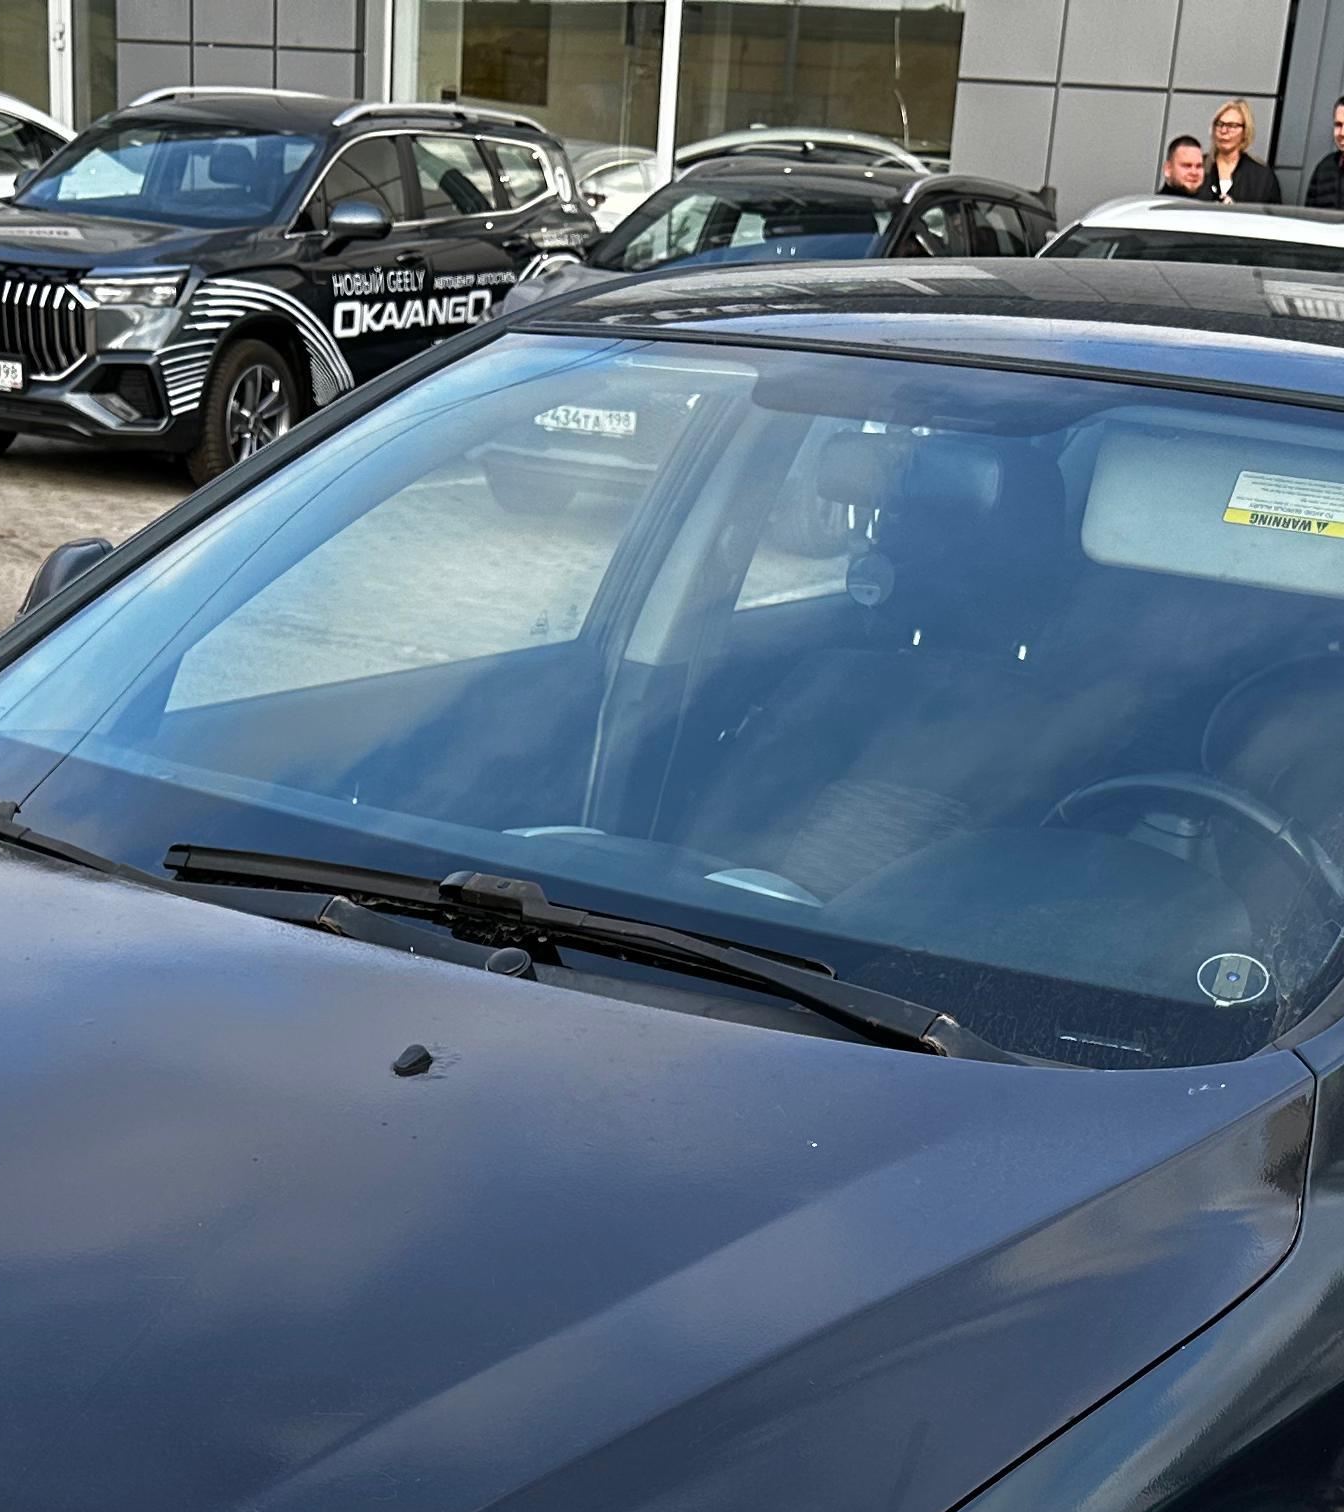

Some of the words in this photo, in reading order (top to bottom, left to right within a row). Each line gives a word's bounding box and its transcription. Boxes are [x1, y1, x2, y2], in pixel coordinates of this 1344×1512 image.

[332, 266, 385, 298] НОВЫЙ
[387, 269, 425, 293] GEELY
[608, 412, 631, 429] 198
[1248, 512, 1312, 532] WARNING
